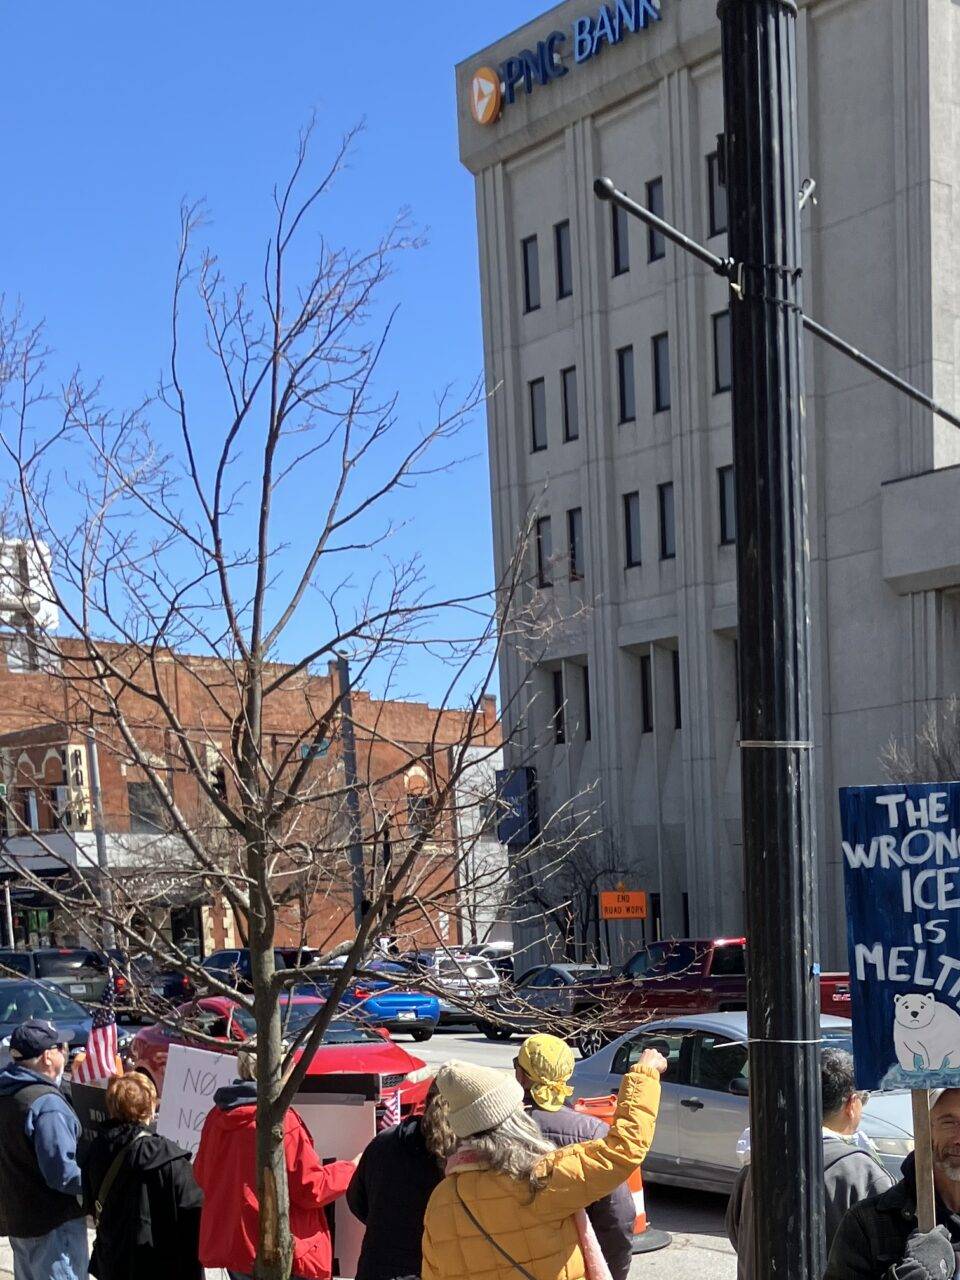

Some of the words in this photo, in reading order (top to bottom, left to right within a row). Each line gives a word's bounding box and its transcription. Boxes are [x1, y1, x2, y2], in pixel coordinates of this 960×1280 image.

[500, 31, 569, 104] PNC
[573, 0, 662, 64] BANK
[875, 792, 949, 829] THE
[604, 906, 622, 914] ROAD
[625, 905, 644, 914] WORK
[617, 895, 630, 903] END
[913, 919, 950, 945] IS
